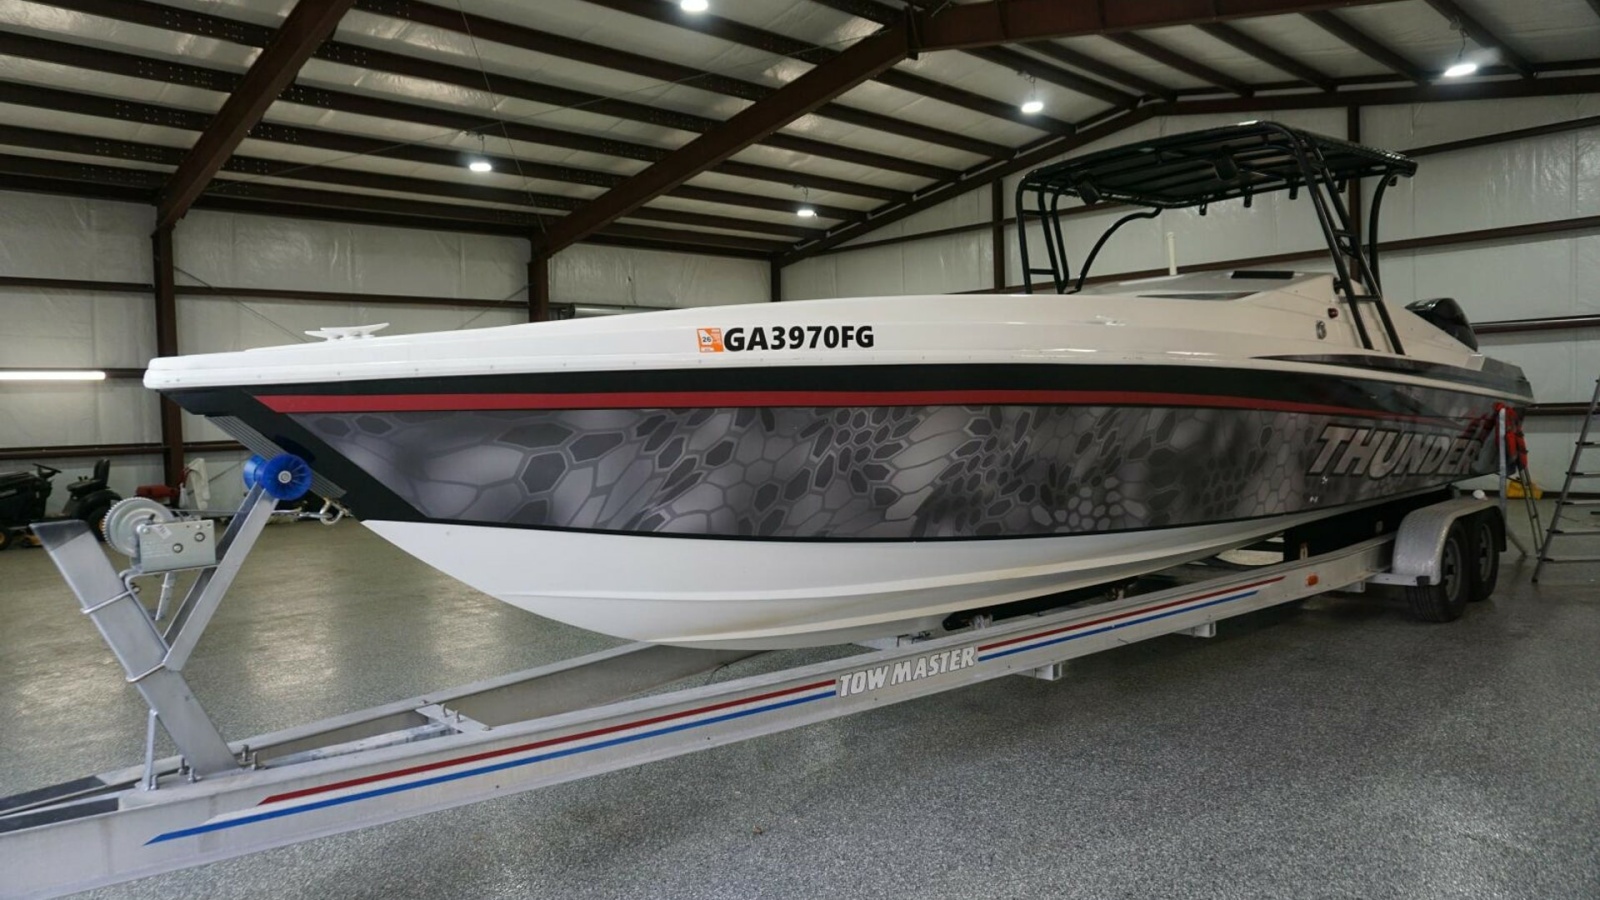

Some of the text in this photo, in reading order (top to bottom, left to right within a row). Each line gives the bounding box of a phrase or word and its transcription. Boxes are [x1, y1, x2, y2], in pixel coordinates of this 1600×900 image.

[724, 325, 874, 351] GA3970FG
[839, 646, 975, 697] TOW MASTER
